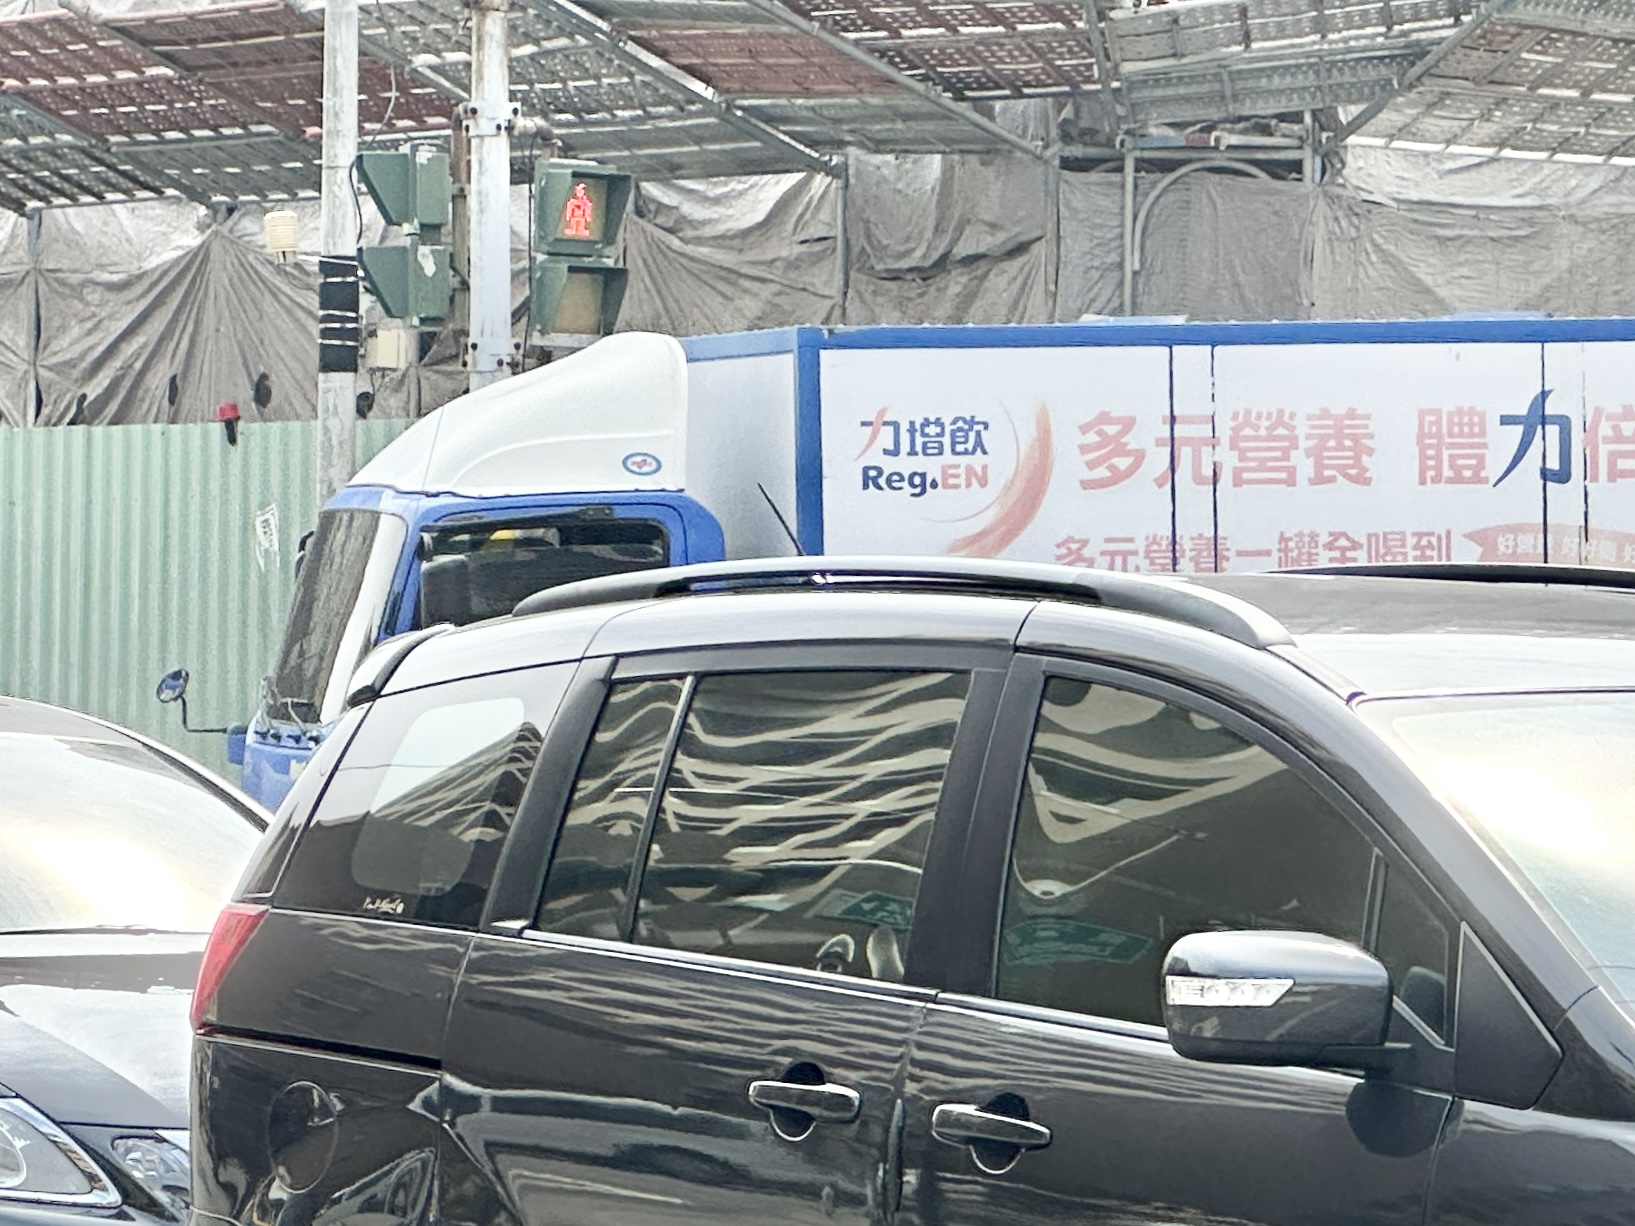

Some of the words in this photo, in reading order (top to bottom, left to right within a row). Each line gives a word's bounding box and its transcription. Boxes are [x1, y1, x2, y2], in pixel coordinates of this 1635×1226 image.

[854, 405, 989, 462] 力增飲
[1077, 407, 1377, 491] 多元營養
